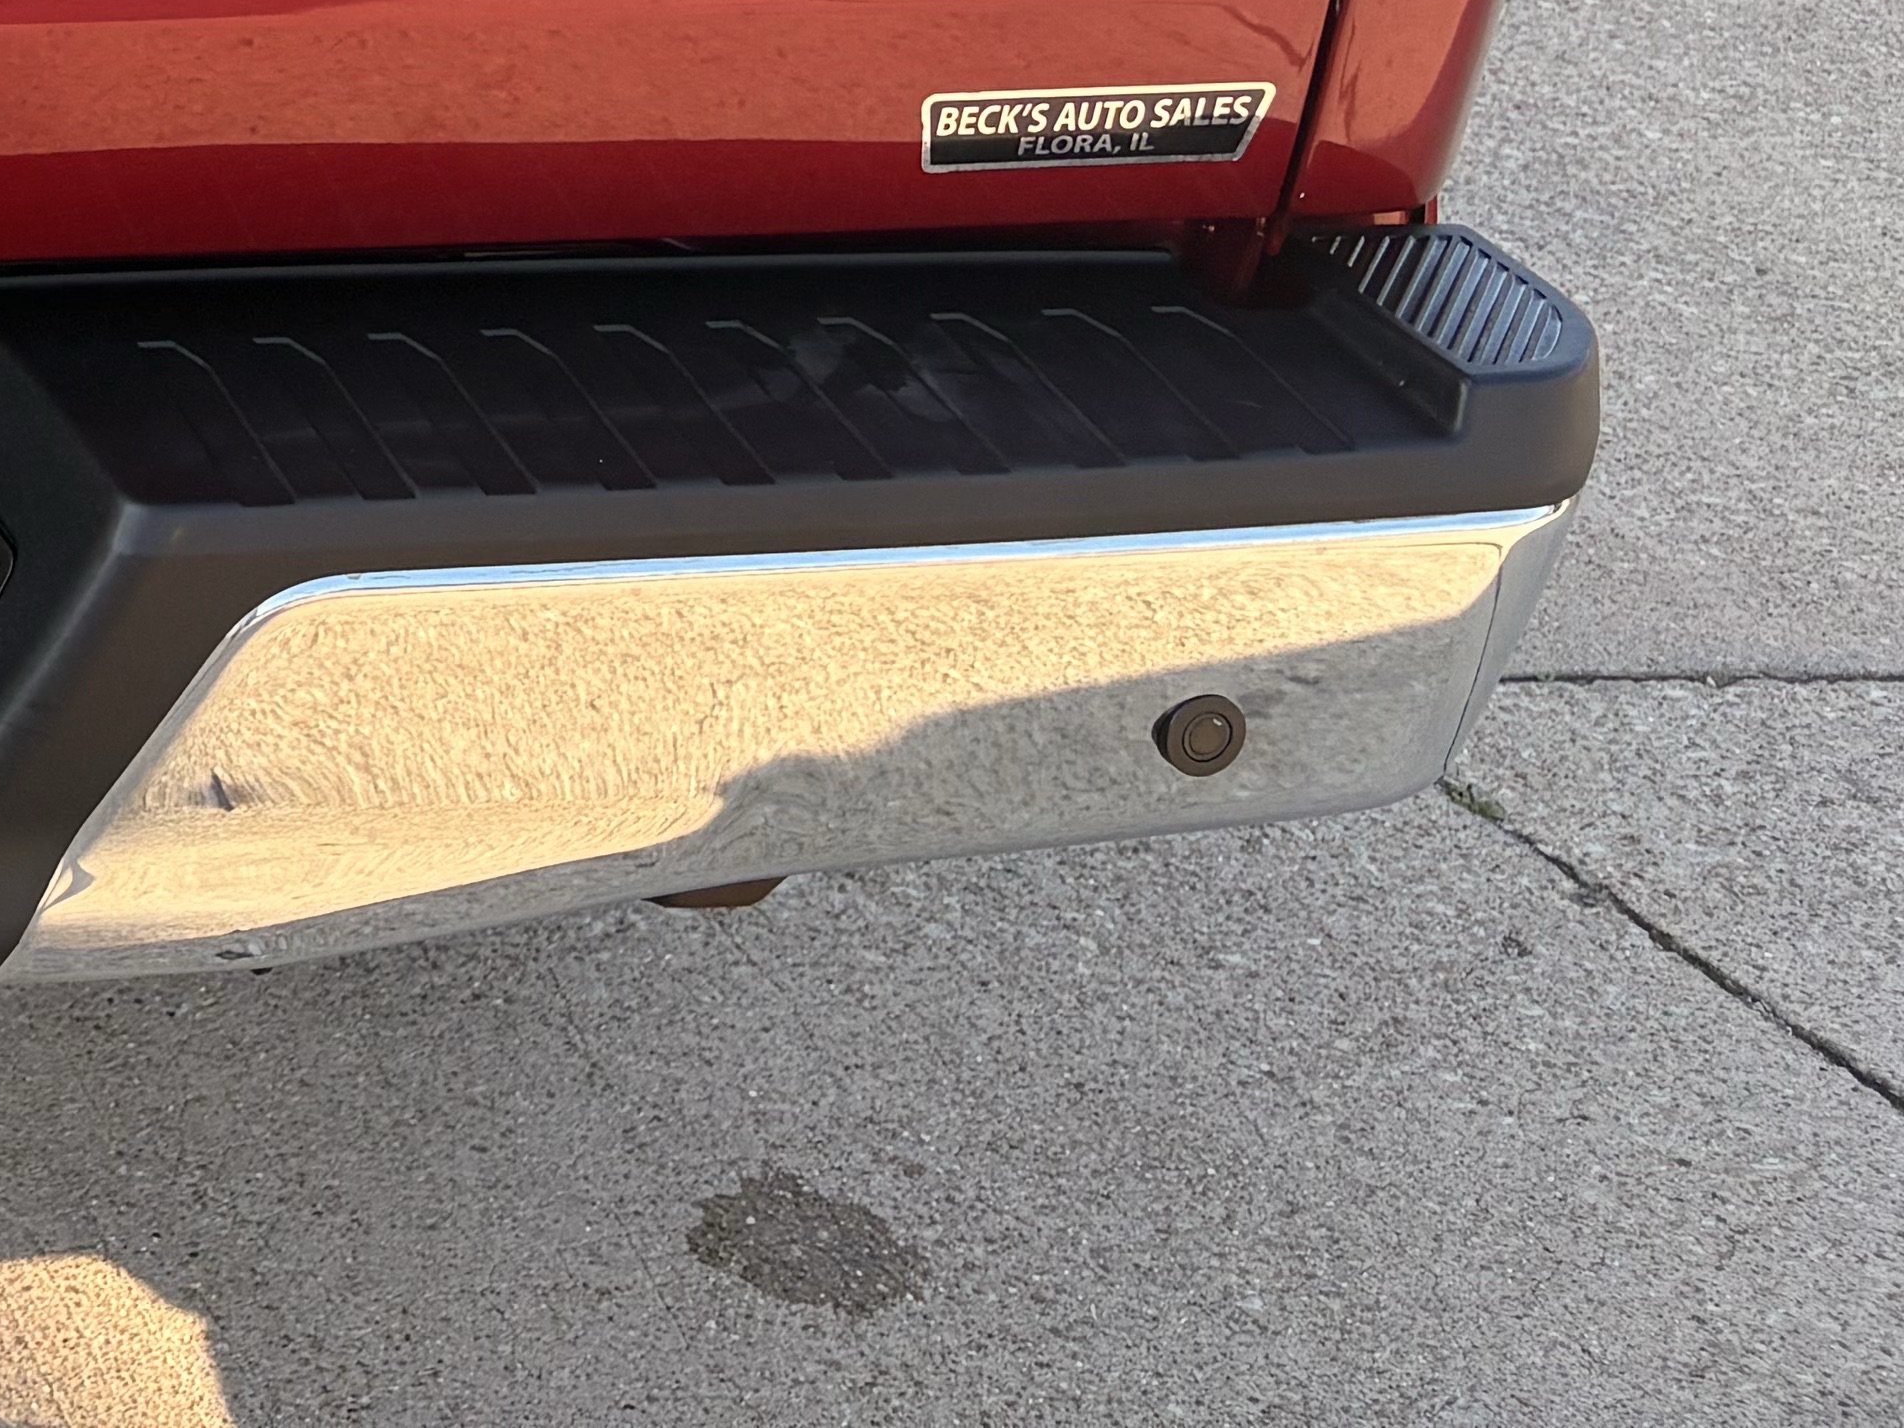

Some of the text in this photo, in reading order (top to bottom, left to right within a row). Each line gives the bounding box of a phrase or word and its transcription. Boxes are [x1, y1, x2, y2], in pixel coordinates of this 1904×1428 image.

[936, 95, 1253, 137] BECK'S AUTO SALES
[1017, 132, 1155, 157] FLORA, IL
